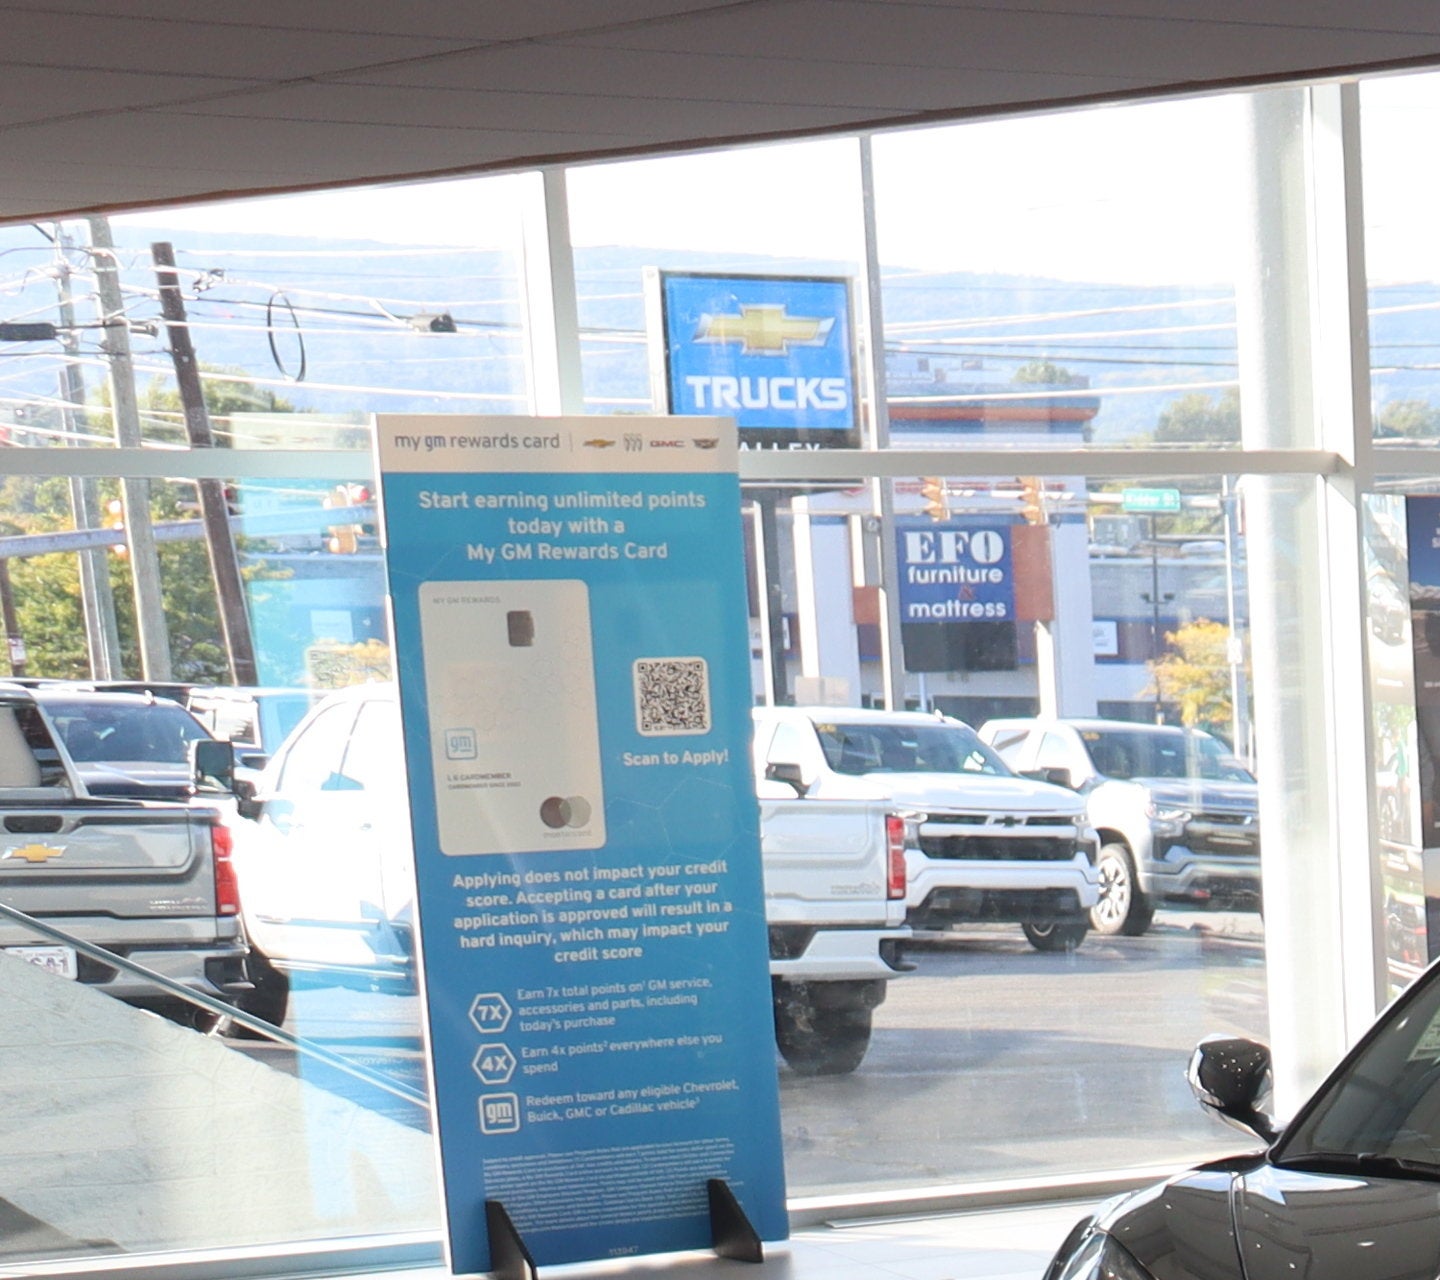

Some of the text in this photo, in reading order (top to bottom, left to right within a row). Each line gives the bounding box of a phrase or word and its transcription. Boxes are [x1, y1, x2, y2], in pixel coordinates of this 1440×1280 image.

[685, 376, 847, 409] TRUCKS
[394, 434, 560, 450] my gm rewards card
[419, 491, 706, 511] Start earning unlimited points
[509, 518, 624, 536] today with a
[467, 543, 667, 563] My GM Rewards Card
[904, 531, 1004, 564] EFO
[908, 567, 1003, 584] furniture
[909, 602, 1006, 617] mattress
[624, 750, 728, 766] Scan to Apply!
[453, 860, 727, 889] Applying does not impact your credit
[466, 882, 718, 907] score. Accepting a card after your
[454, 901, 732, 931] application is approved will result in a
[460, 920, 729, 948] hard inquiry, which may impact your
[554, 947, 642, 963] credit score
[517, 977, 712, 1000] Earn 7x total points GM service,
[478, 1004, 503, 1021] 7X
[518, 993, 698, 1017] accessories and parts, including
[520, 1015, 616, 1032] today's purchase
[522, 1033, 723, 1058] Earn 4x everywhere else you
[481, 1055, 508, 1072] 4X
[523, 1062, 558, 1076] spend
[527, 1079, 740, 1106] Redeem toward any eligible Chevrolet,
[486, 1103, 512, 1124] gm
[528, 1099, 654, 1123] Buick, GMC or Cadillac
